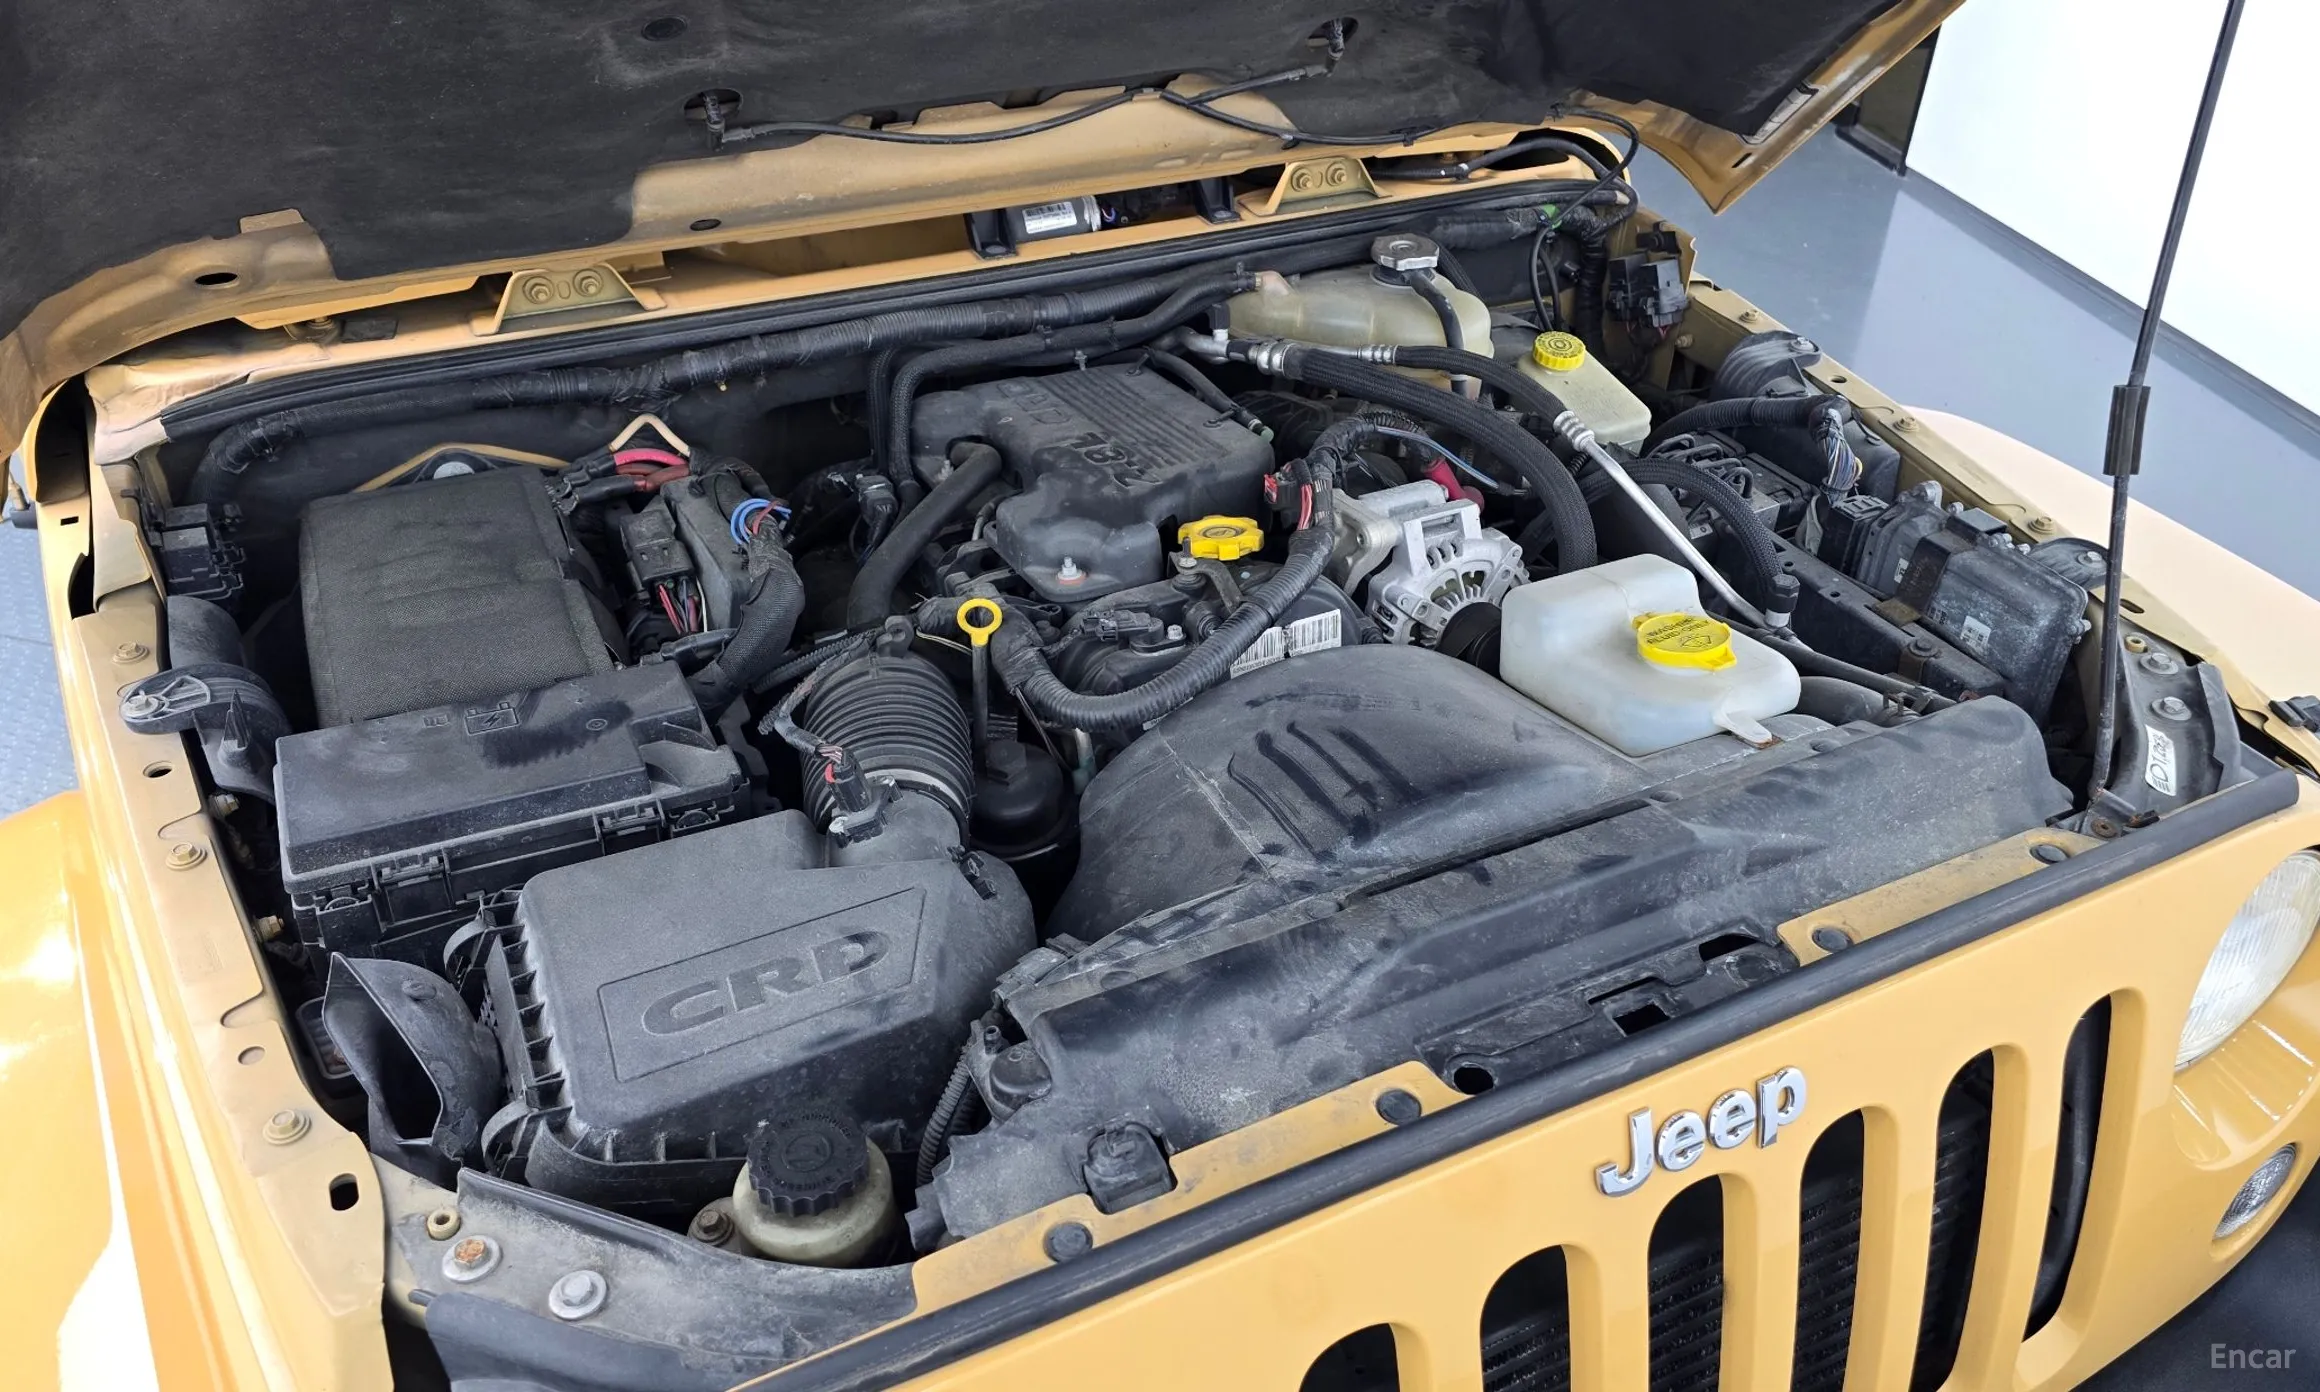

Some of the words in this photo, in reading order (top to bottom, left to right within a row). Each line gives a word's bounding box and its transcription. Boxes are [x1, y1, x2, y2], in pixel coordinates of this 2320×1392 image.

[1646, 631, 1681, 644] FLUID
[1681, 619, 1710, 632] ONLY
[641, 930, 890, 1036] CRD
[1595, 1065, 1807, 1198] Jeep
